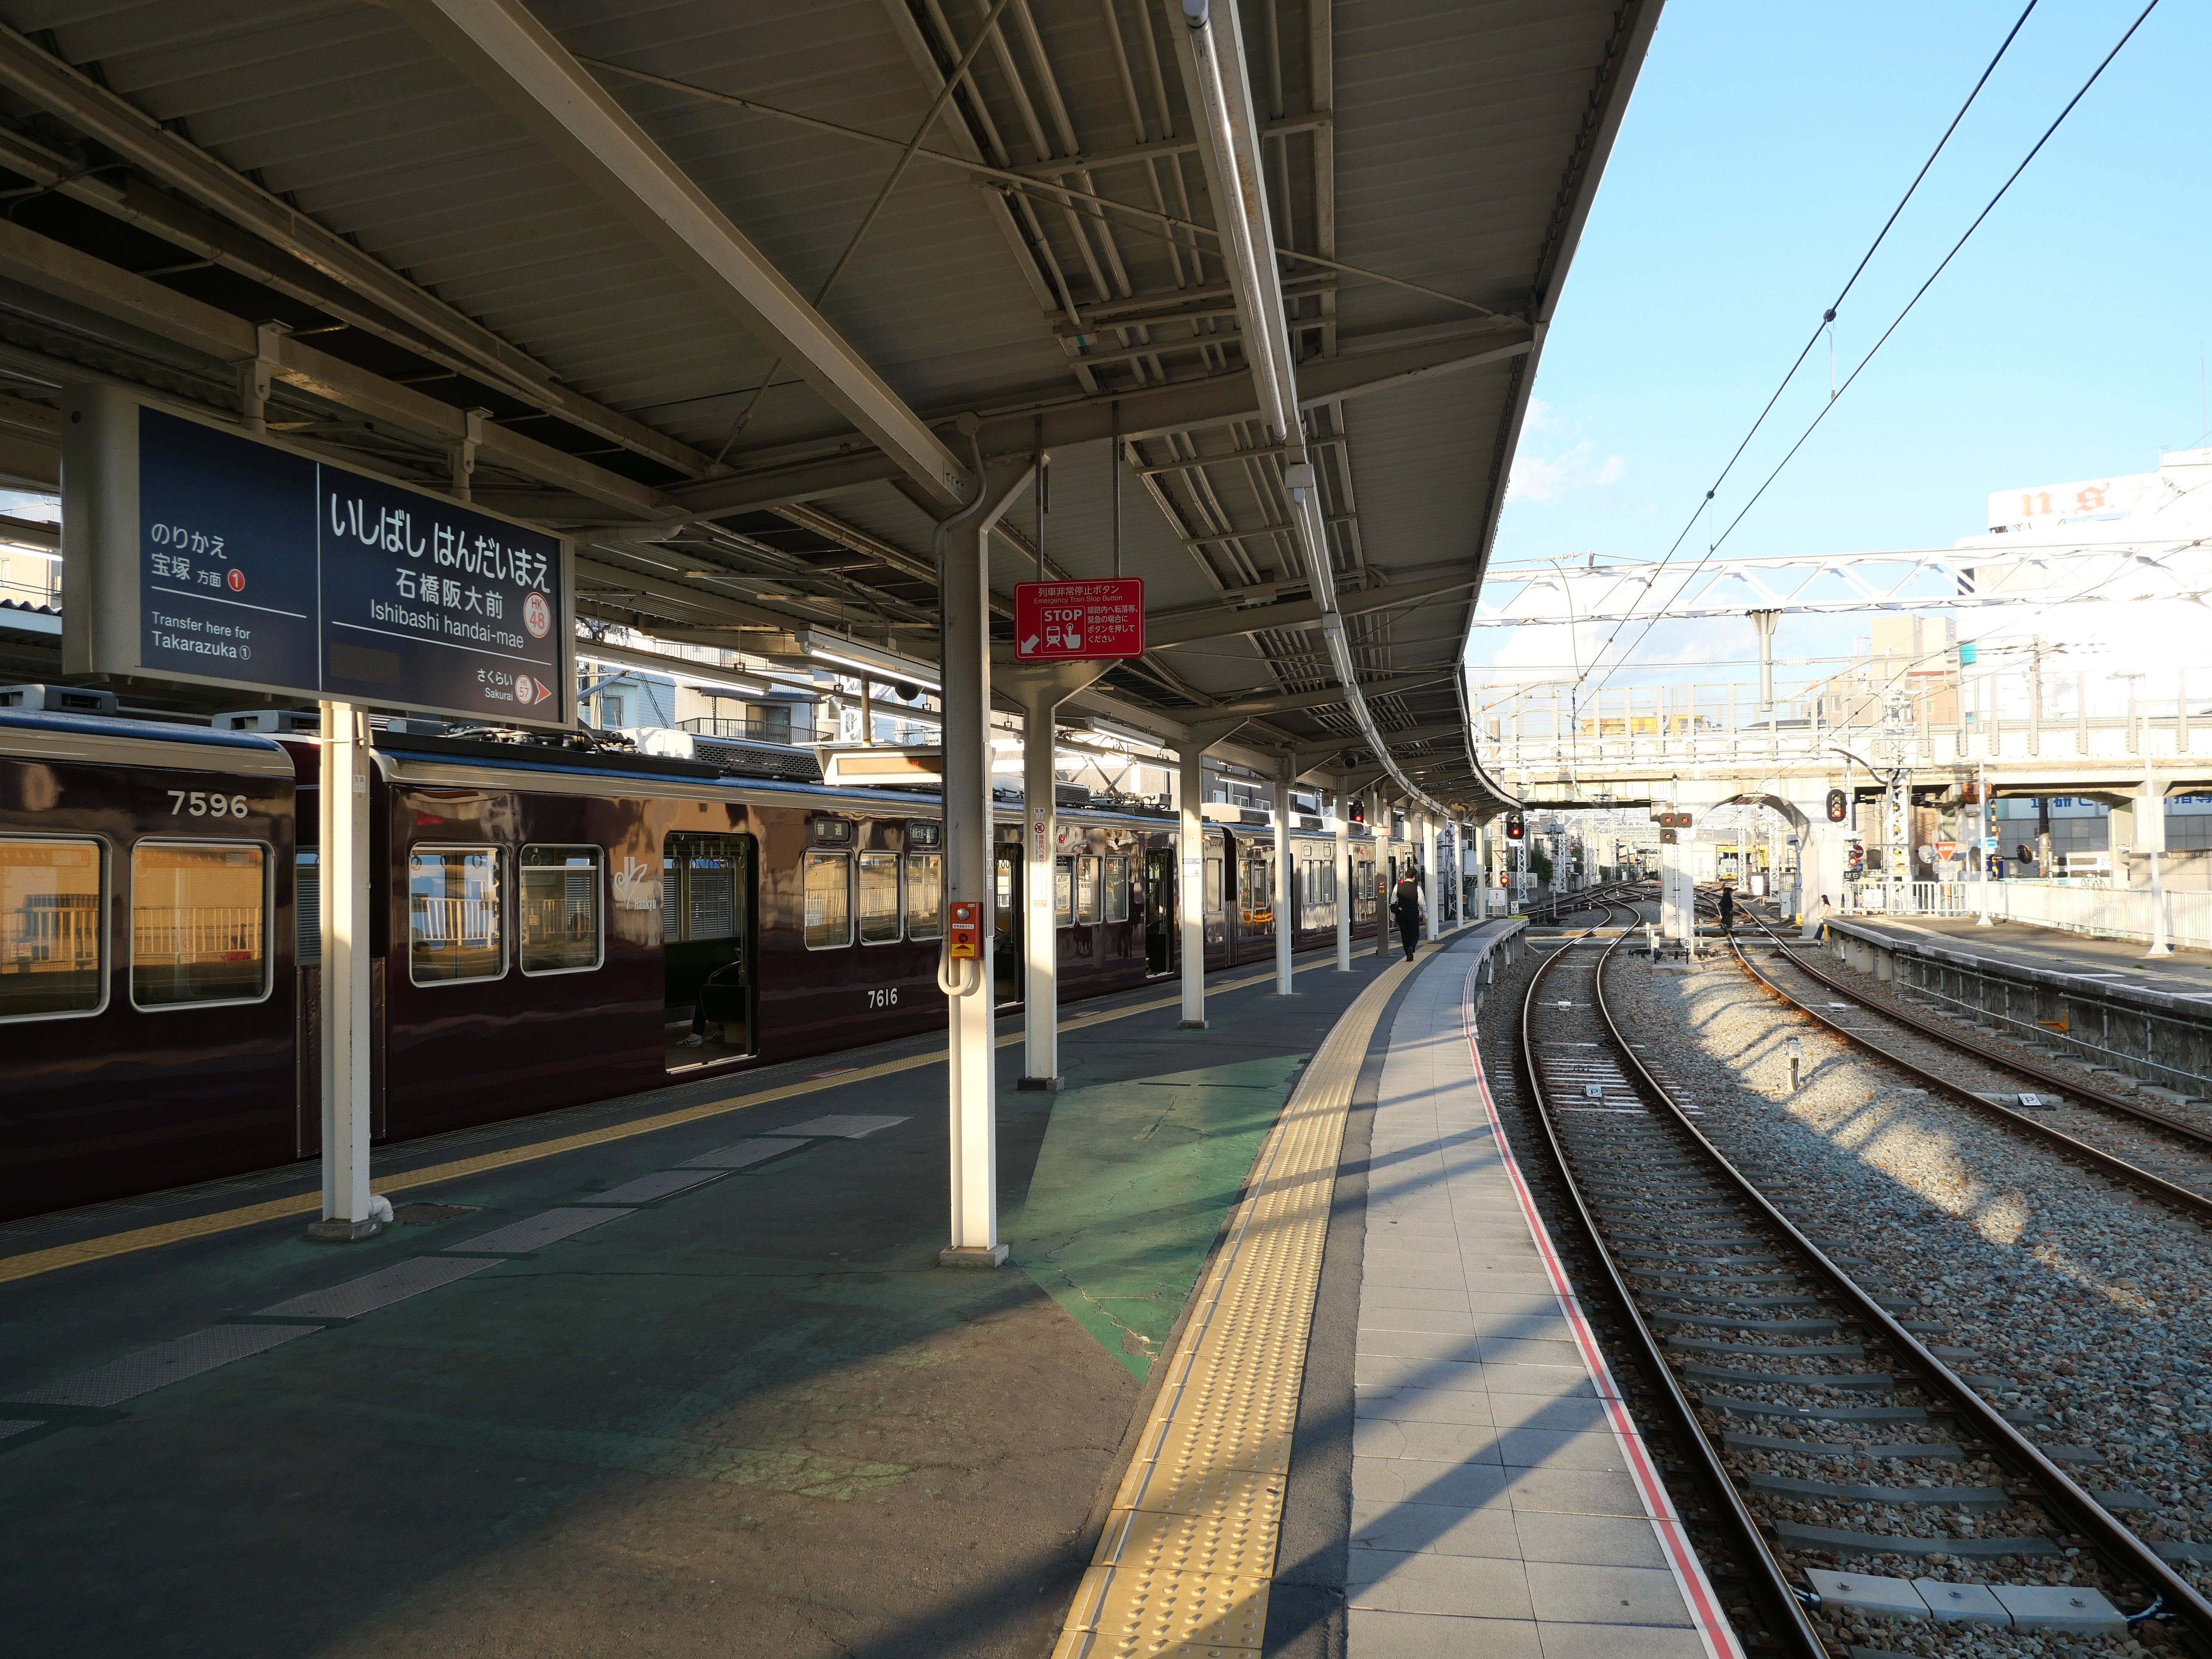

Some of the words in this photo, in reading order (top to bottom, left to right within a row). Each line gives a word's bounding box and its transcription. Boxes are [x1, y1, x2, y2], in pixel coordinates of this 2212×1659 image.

[151, 524, 227, 559] のりかえ
[332, 493, 425, 557] いしばし
[434, 522, 550, 593] はんだいまえ
[151, 553, 191, 580] 宝塚
[197, 570, 221, 588] 方面
[396, 568, 503, 620] 石橋阪大前
[1038, 585, 1119, 597] 列車非常停止ボタン
[531, 598, 542, 611] HK
[371, 599, 439, 632] Ishibashi
[445, 615, 524, 649] handai-mae
[529, 611, 545, 630] 48
[1044, 609, 1082, 622] STOP
[1087, 615, 1128, 624] 緊急の場合に
[151, 611, 203, 632] Transfer
[206, 621, 232, 637] here
[234, 626, 251, 640] for
[1088, 625, 1135, 633] ボタンを押して
[151, 631, 237, 658] Takarazuka
[1088, 635, 1115, 643] ください
[477, 669, 513, 686] さくらい
[485, 687, 513, 701] Sakurai
[519, 687, 530, 698] 57
[167, 790, 248, 818] 7596
[817, 823, 843, 835] 普通
[634, 896, 656, 911] Hankyu
[868, 988, 897, 1009] 7616
